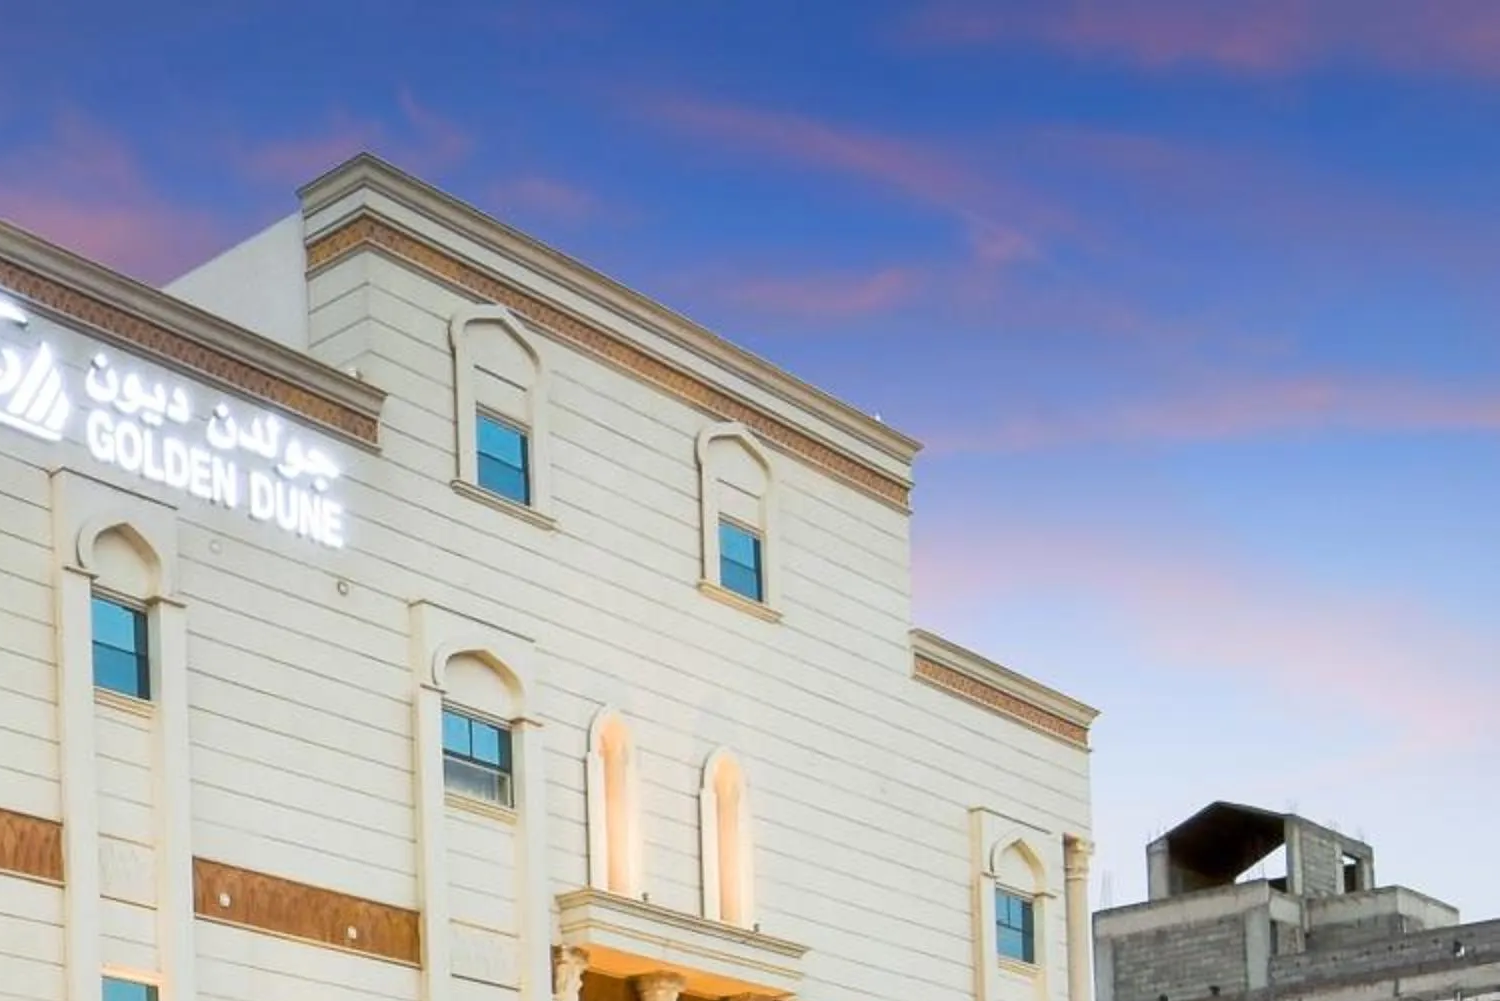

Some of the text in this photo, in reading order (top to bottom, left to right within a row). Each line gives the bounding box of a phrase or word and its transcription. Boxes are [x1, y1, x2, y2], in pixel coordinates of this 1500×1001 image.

[85, 353, 342, 491] جولدن ديون
[86, 408, 345, 549] GOLDEN DUNE
